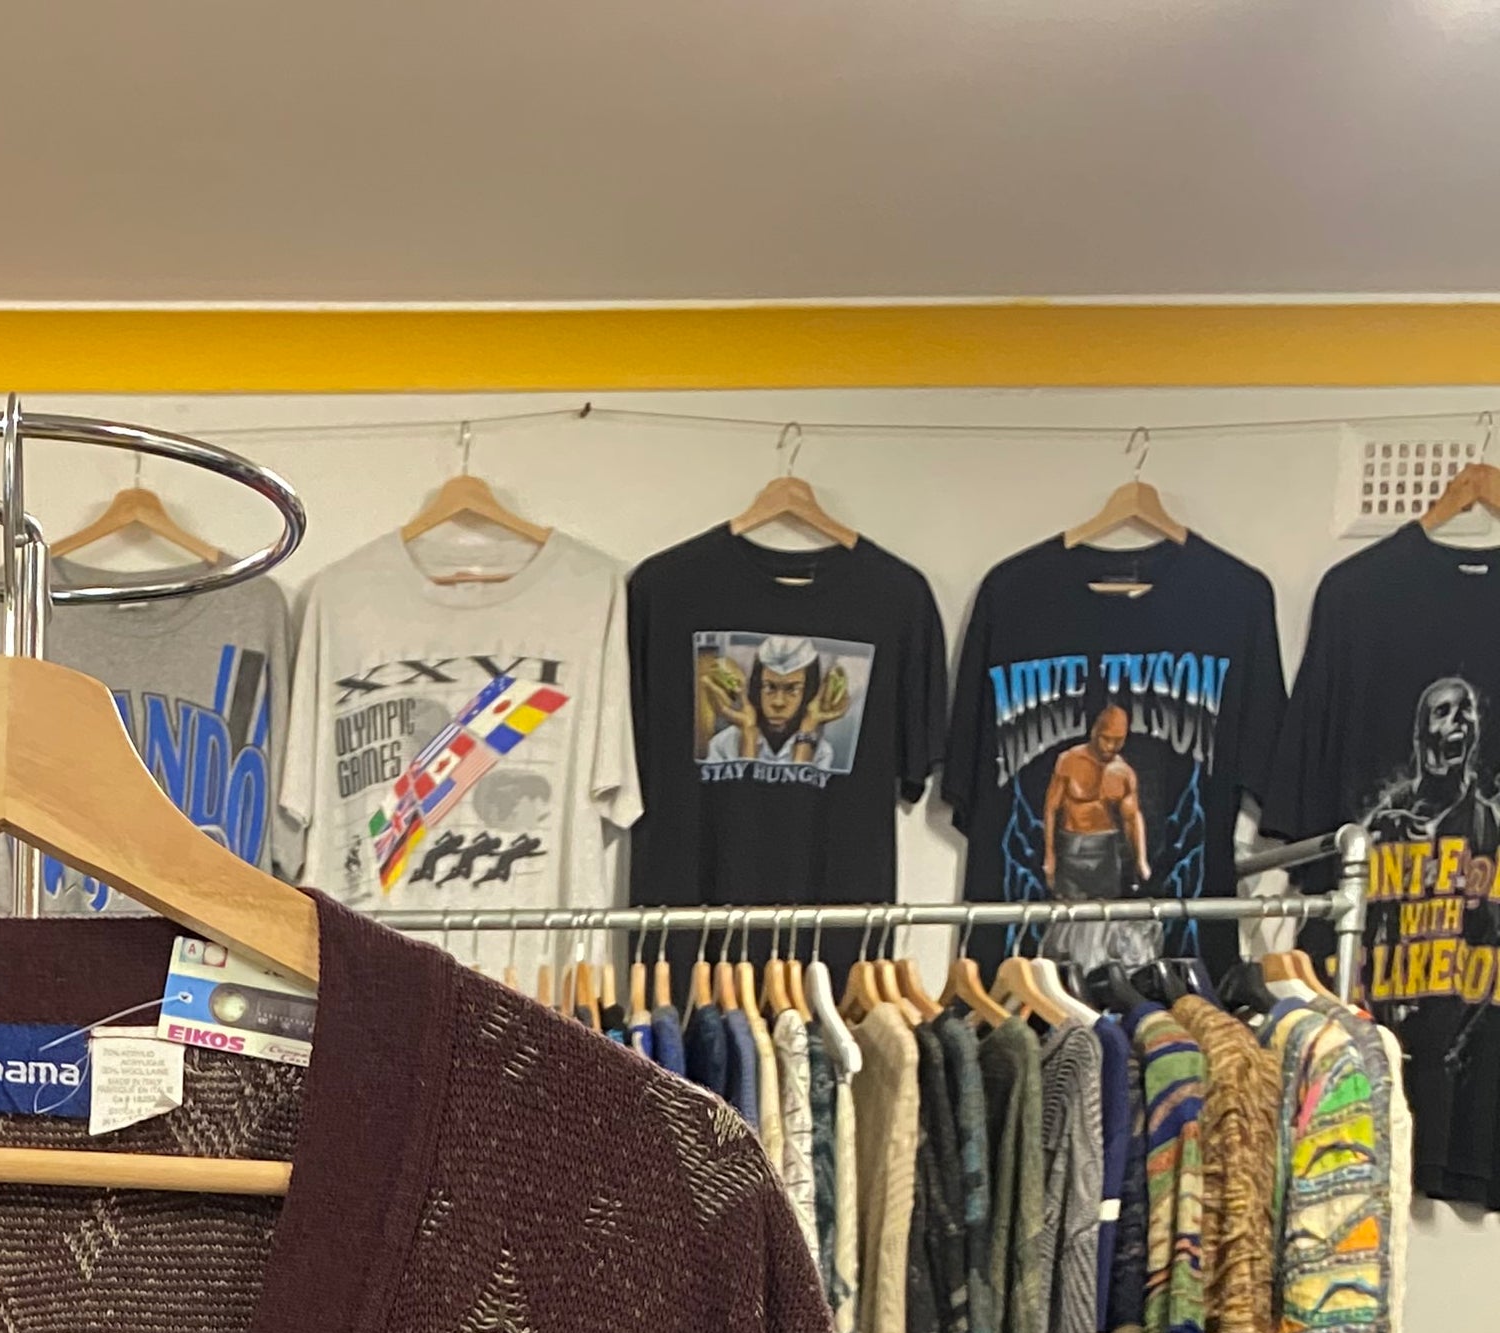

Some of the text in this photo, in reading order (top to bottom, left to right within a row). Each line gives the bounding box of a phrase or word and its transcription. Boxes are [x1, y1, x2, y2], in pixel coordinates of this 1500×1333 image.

[335, 655, 562, 704] XXVI
[335, 697, 416, 757] OLYMPIC
[989, 652, 1230, 787] MIKE TYSON
[338, 740, 401, 799] GAMES
[701, 762, 749, 781] STAY
[1401, 898, 1462, 936] WITH
[167, 1024, 246, 1051] EIKOS
